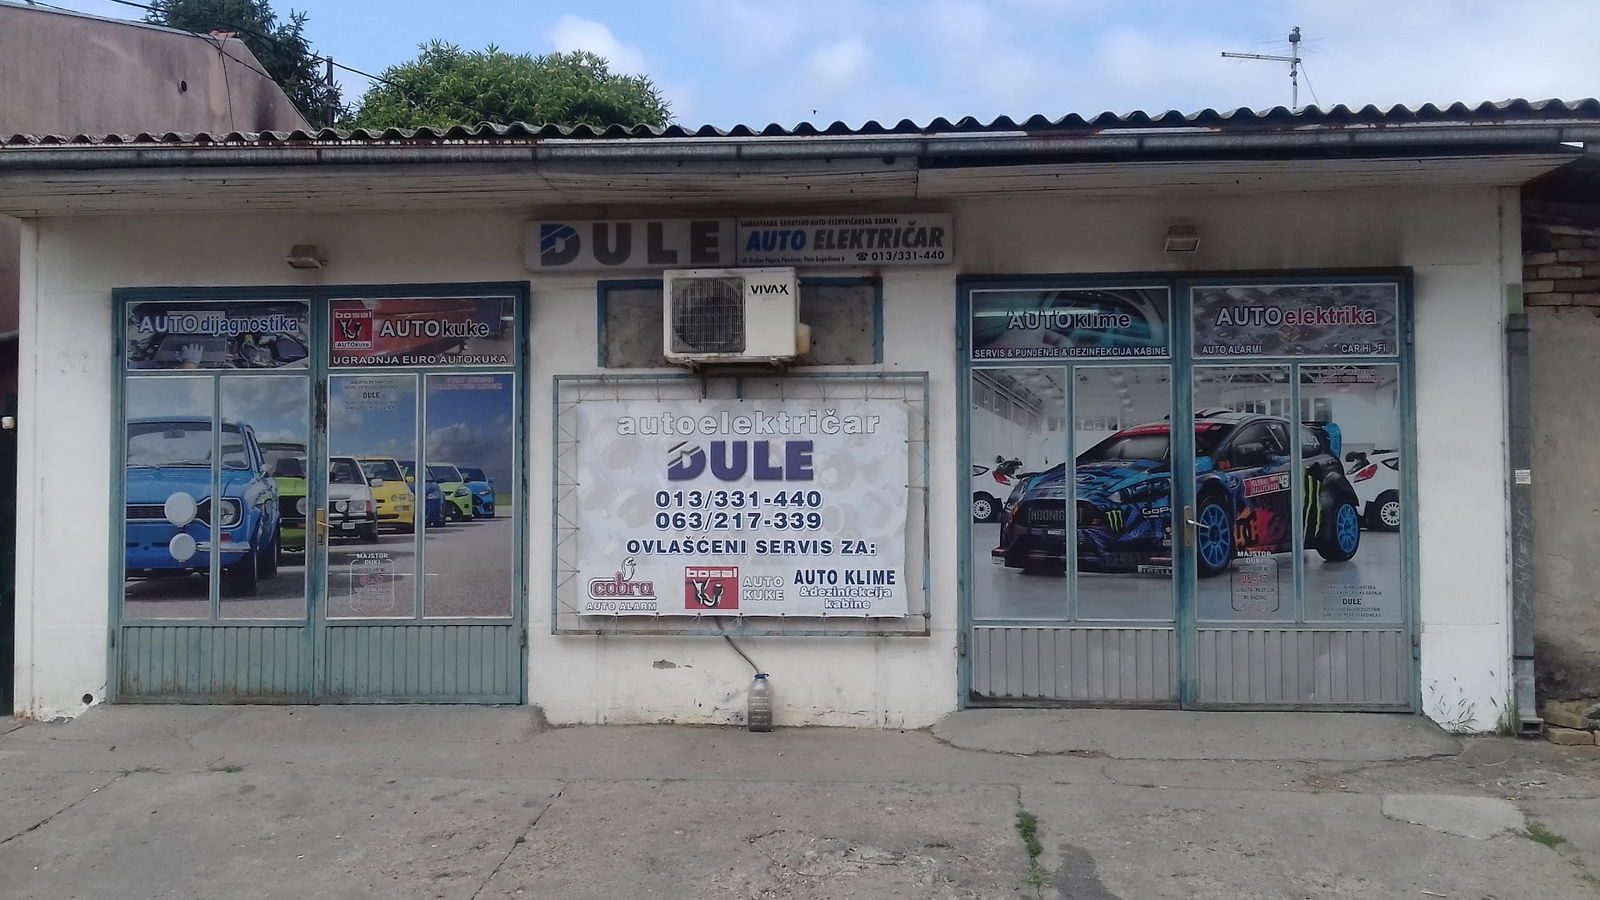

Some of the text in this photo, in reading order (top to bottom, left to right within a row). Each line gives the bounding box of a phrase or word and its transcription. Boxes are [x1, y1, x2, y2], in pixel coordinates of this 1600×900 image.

[745, 221, 945, 251] AUTO ELEKTRIČAR
[540, 221, 720, 266] DULE
[871, 251, 945, 261] 013/331-440
[750, 284, 789, 295] VIVAX
[974, 346, 1167, 358] SERVIS & PUNJENJE & DEZINFEKCIJA KABINE
[1228, 345, 1262, 354] ALARMI
[1341, 344, 1360, 353] CAR
[332, 354, 508, 365] UGRADNJA EURO AUTOKUKA
[616, 409, 881, 436] autoelektričar
[667, 439, 814, 482] DULE
[655, 490, 823, 509] 013/331-440
[655, 511, 823, 531] 063/217-339
[626, 536, 877, 555] OVLAŠĆENI SERVIS ZA:
[686, 568, 738, 578] bosal
[794, 569, 896, 585] AUTO KLIME
[589, 571, 656, 598] cobra
[742, 576, 784, 588] AUTO
[742, 589, 784, 601] KUKE
[799, 586, 892, 599] &dezinfekcija
[586, 602, 657, 611] AUTO ALARM
[824, 598, 871, 609] kabine
